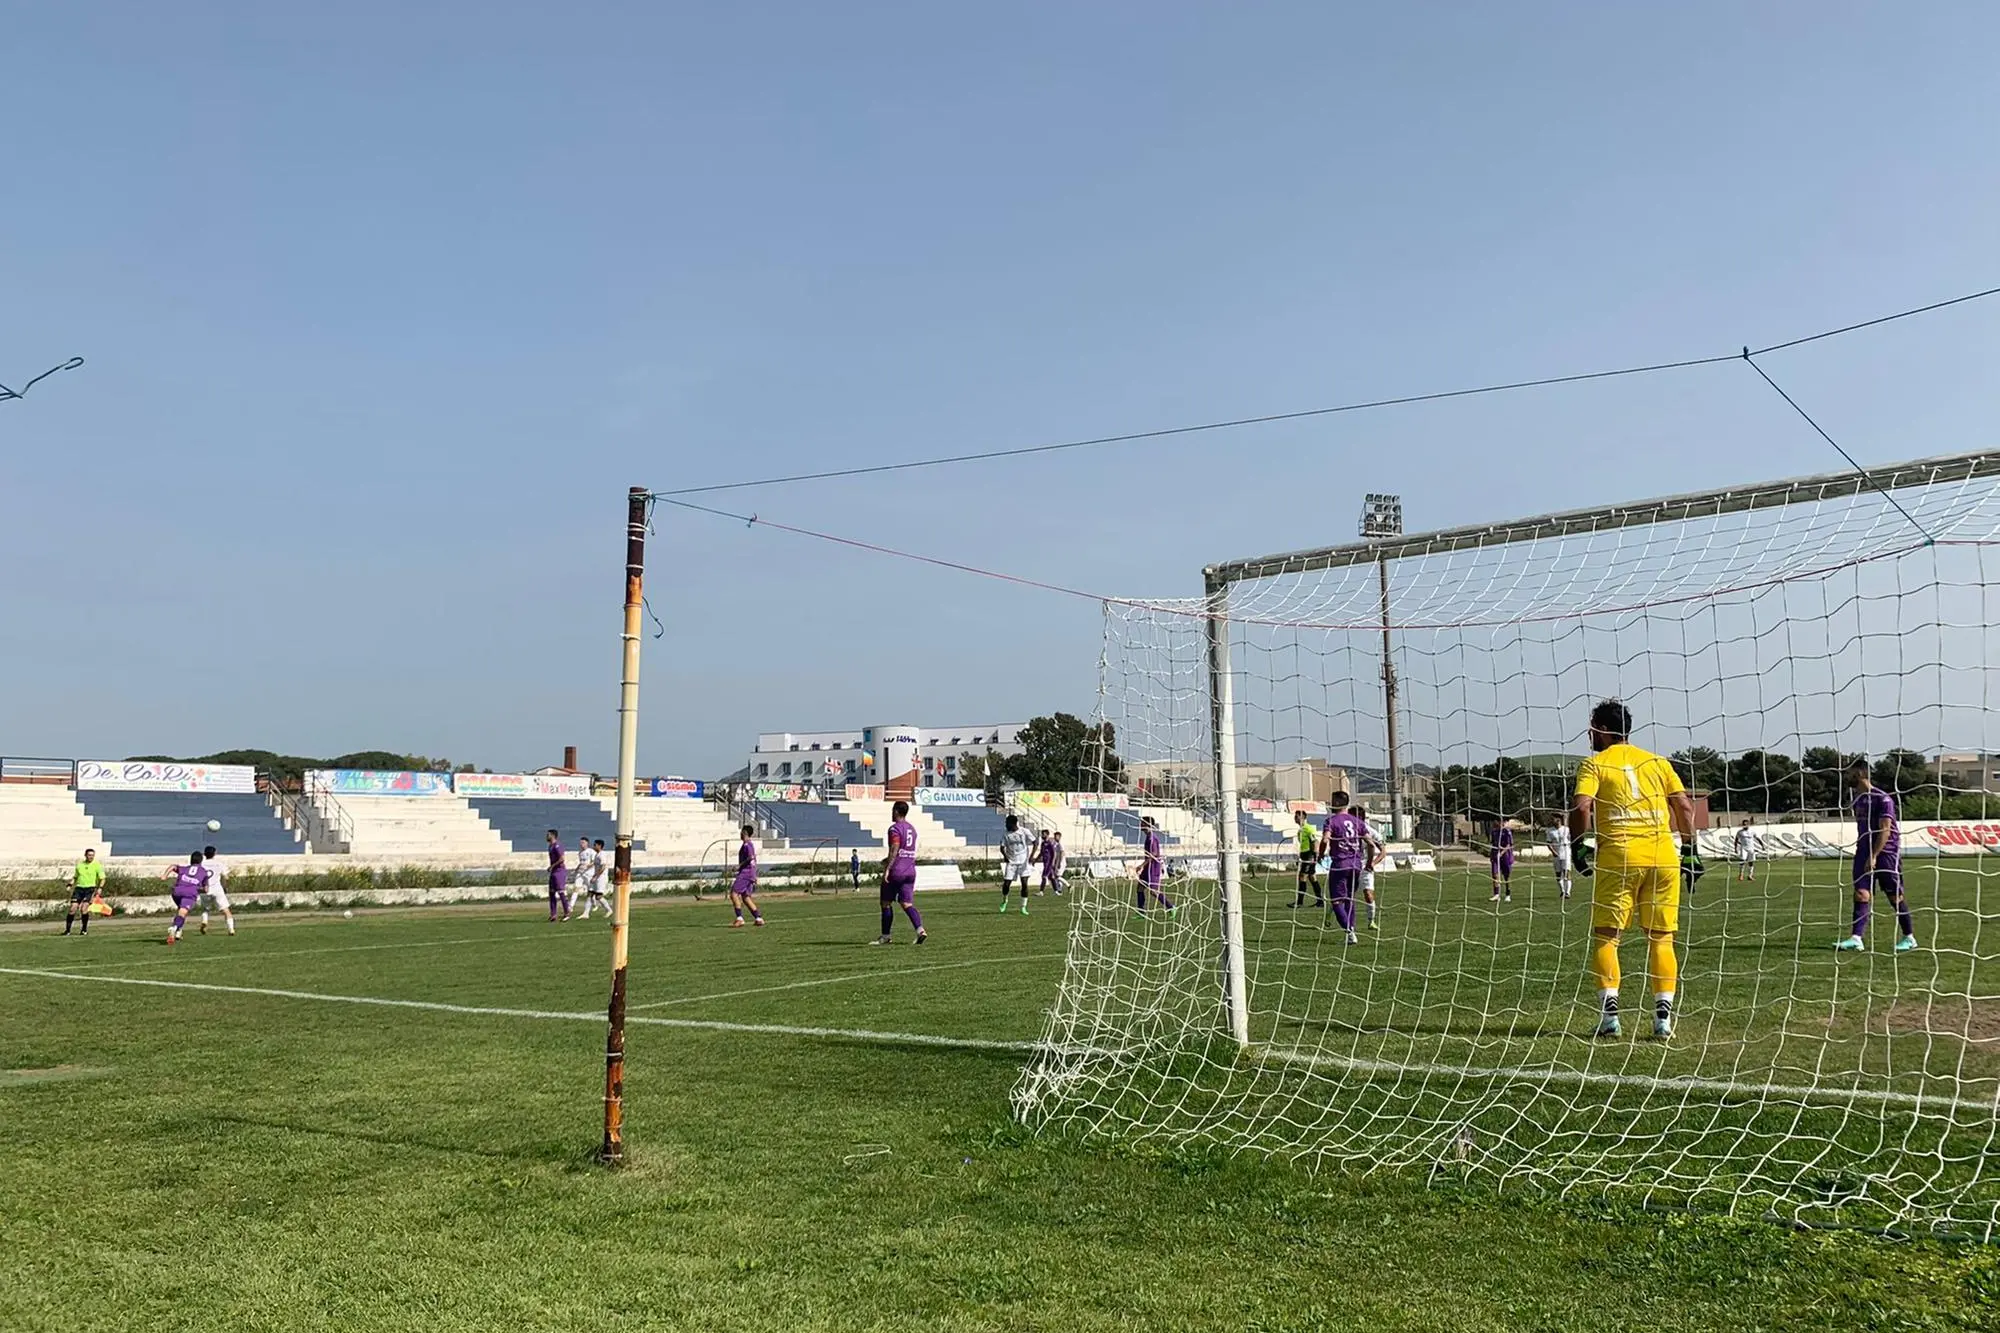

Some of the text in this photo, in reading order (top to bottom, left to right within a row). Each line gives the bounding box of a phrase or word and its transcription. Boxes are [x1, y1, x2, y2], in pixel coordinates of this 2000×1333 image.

[540, 783, 588, 798] MaxMeyer
[933, 792, 974, 802] GAVIANO
[1343, 820, 1355, 838] 3
[906, 829, 913, 847] 5
